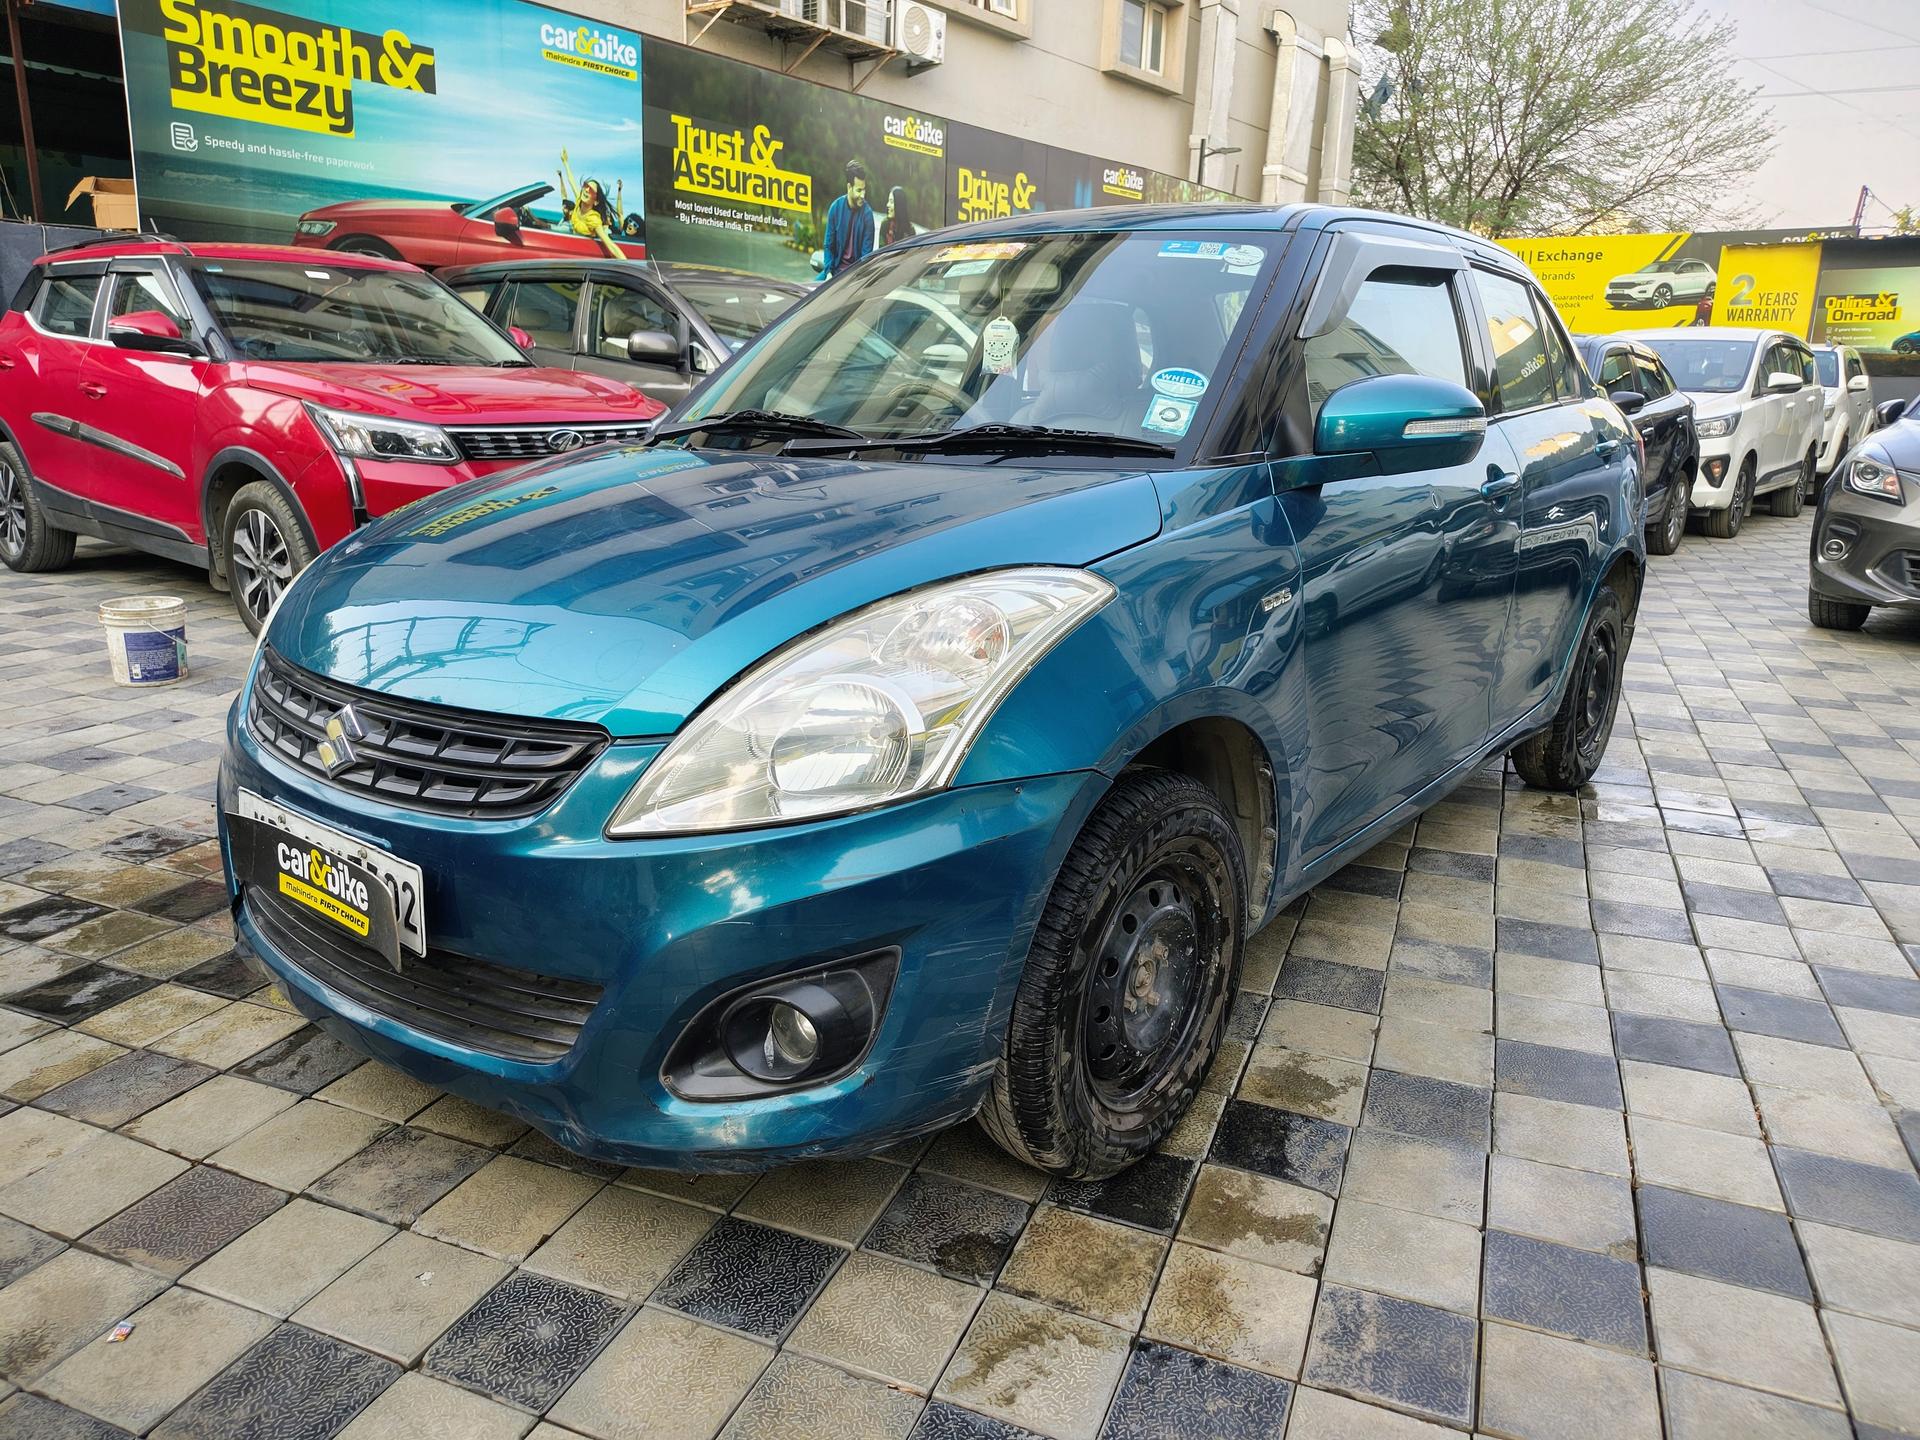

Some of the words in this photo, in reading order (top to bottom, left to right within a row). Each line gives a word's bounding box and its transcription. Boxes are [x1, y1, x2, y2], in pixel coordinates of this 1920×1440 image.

[160, 0, 372, 82] Smooth
[378, 28, 435, 93] &
[541, 24, 637, 67] car&bike
[582, 61, 604, 71] FIRST
[604, 67, 630, 77] CHOICE
[170, 43, 354, 133] Breezy
[671, 114, 745, 161] Trust
[750, 124, 784, 170] &
[883, 115, 944, 146] car&bike
[204, 135, 245, 153] Speedy
[247, 143, 267, 155] and
[269, 146, 324, 164] hassle-free
[326, 157, 376, 171] paperwork
[673, 150, 809, 207] Assurance
[958, 167, 1009, 204] Drive
[1012, 172, 1037, 210] &
[675, 199, 693, 211] Most
[694, 203, 713, 215] loved
[714, 207, 731, 218] Used
[732, 210, 743, 220] Car
[744, 212, 763, 223] brand
[763, 216, 771, 224] of
[772, 216, 788, 227] India
[680, 212, 690, 225] By
[691, 214, 724, 229] Franchise
[744, 224, 753, 233] ET
[1537, 249, 1603, 263] Exchange
[1542, 271, 1576, 281] brands
[1729, 273, 1755, 306] 2
[1758, 292, 1799, 306] YEARS
[1727, 308, 1796, 322] WARRANTY
[1825, 295, 1872, 309] Online
[1875, 290, 1898, 307] &
[1832, 307, 1897, 321] On-road
[1161, 373, 1204, 386] WHEELS
[277, 842, 369, 911] car&bike
[319, 898, 340, 915] FIRST
[340, 910, 366, 930] CHOICE
